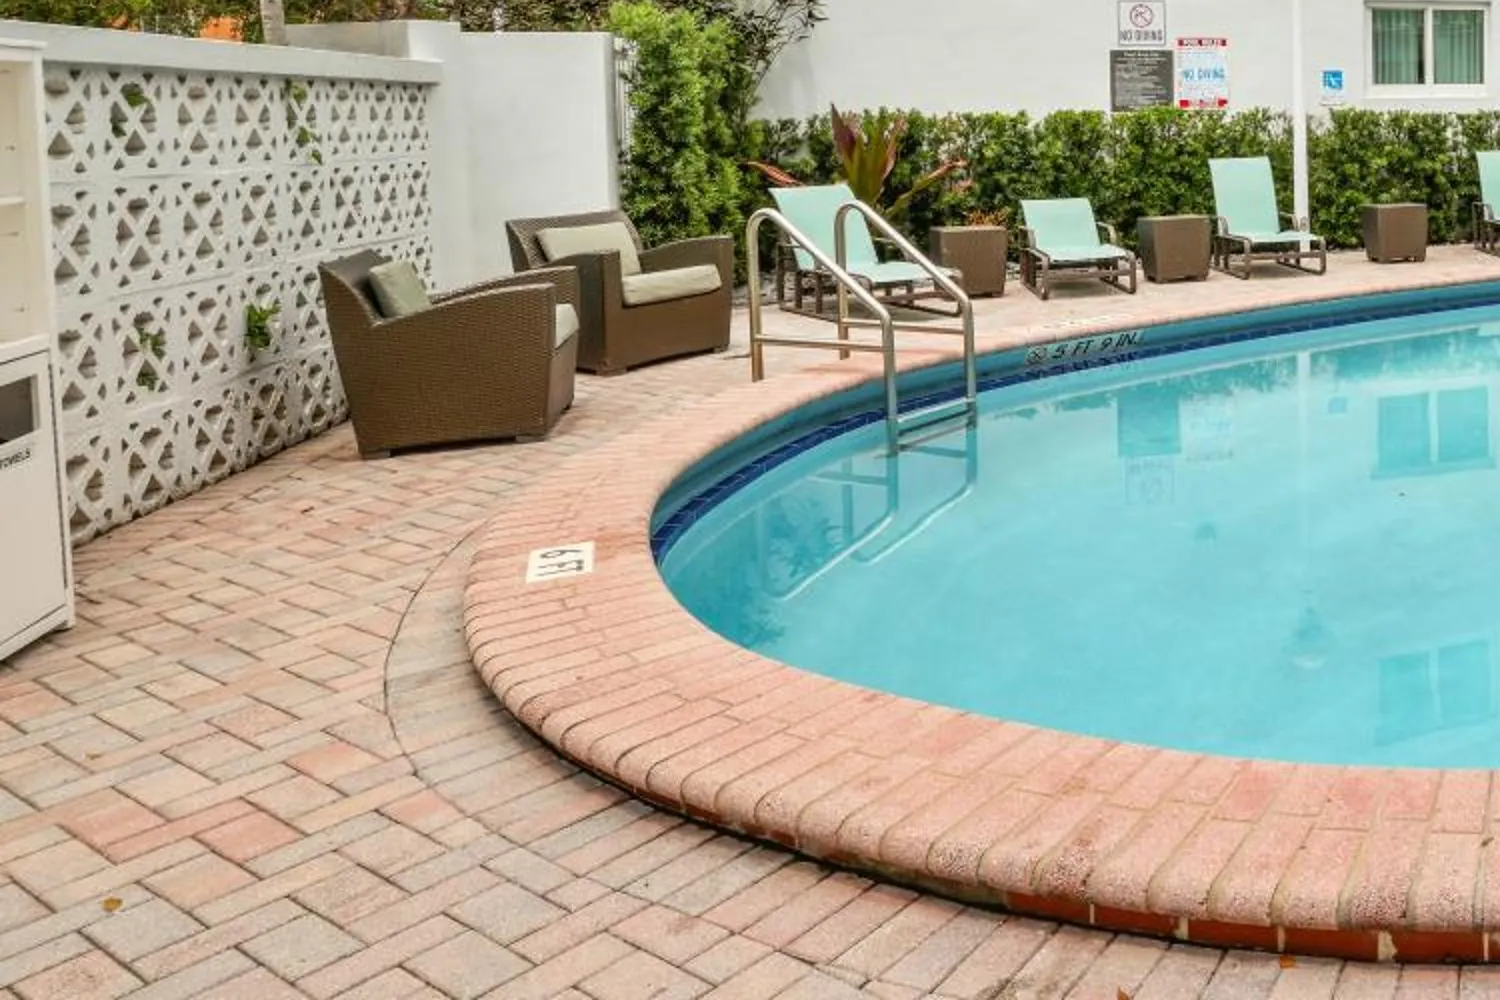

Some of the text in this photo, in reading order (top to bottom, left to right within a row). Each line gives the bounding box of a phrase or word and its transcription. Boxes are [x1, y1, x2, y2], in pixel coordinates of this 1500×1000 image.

[1119, 30, 1162, 41] NO DIVING
[1183, 68, 1195, 80] NO
[1051, 343, 1069, 359] 5
[1071, 339, 1095, 357] FT
[1100, 337, 1113, 352] 9
